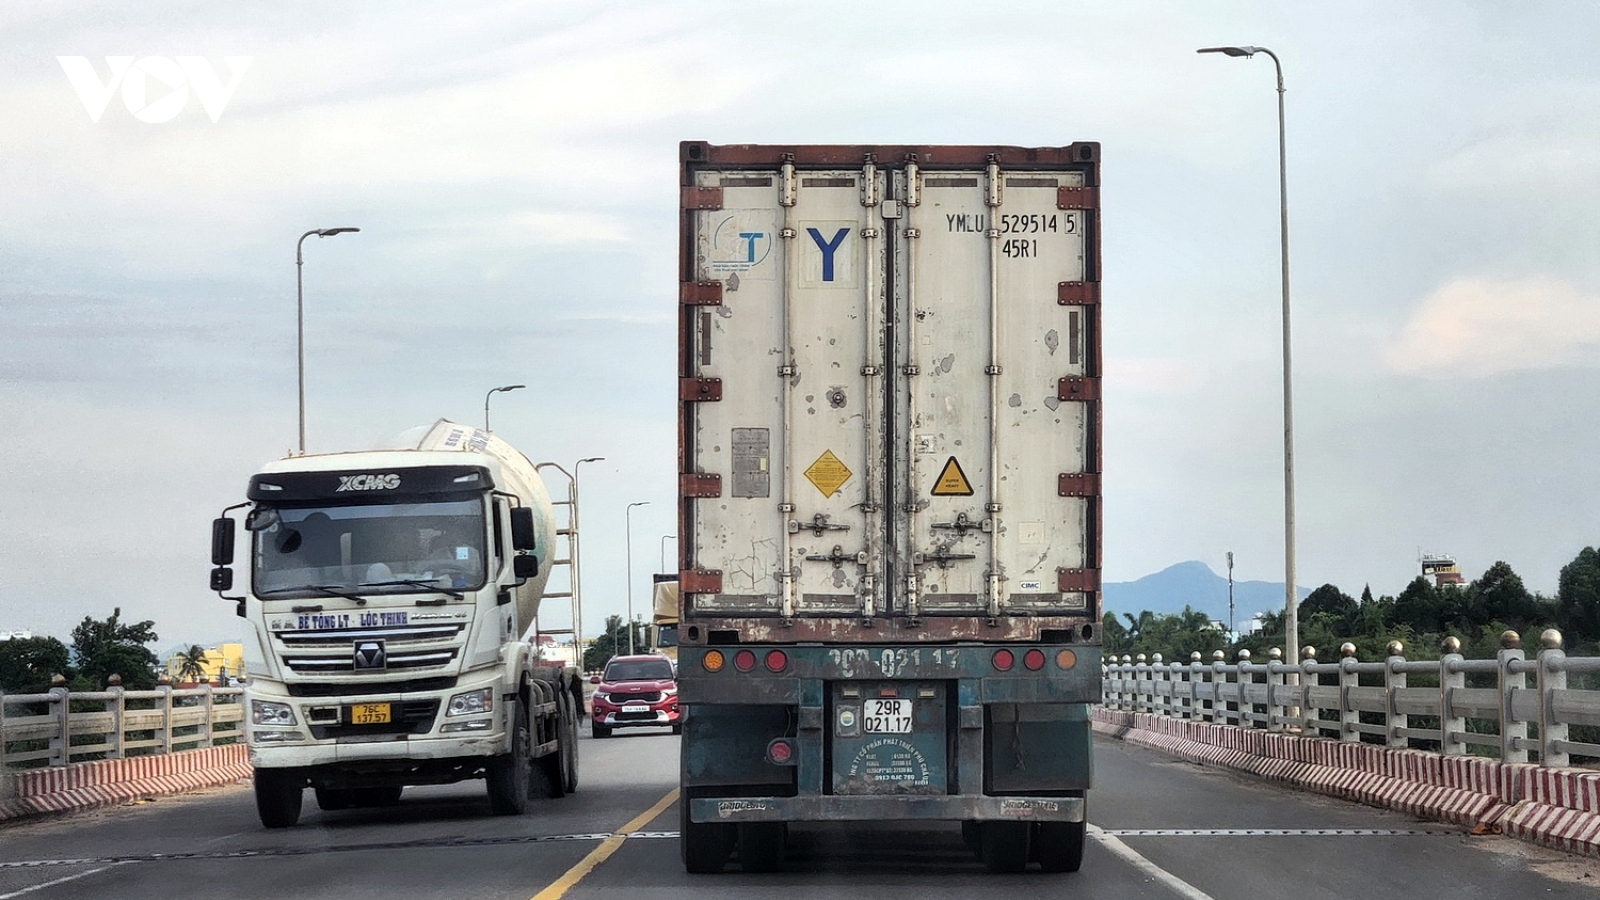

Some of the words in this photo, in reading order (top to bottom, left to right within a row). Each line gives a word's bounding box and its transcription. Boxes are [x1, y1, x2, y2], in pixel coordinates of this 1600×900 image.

[946, 213, 985, 233] YMLU
[1001, 214, 1058, 233] 529514
[1066, 214, 1075, 233] 5
[806, 228, 851, 281] Y
[1002, 239, 1037, 258] 45R1
[336, 474, 401, 492] XCMG
[338, 614, 350, 628] LT
[363, 705, 380, 713] 76C
[875, 701, 901, 715] 29R
[865, 717, 911, 731] 021.17
